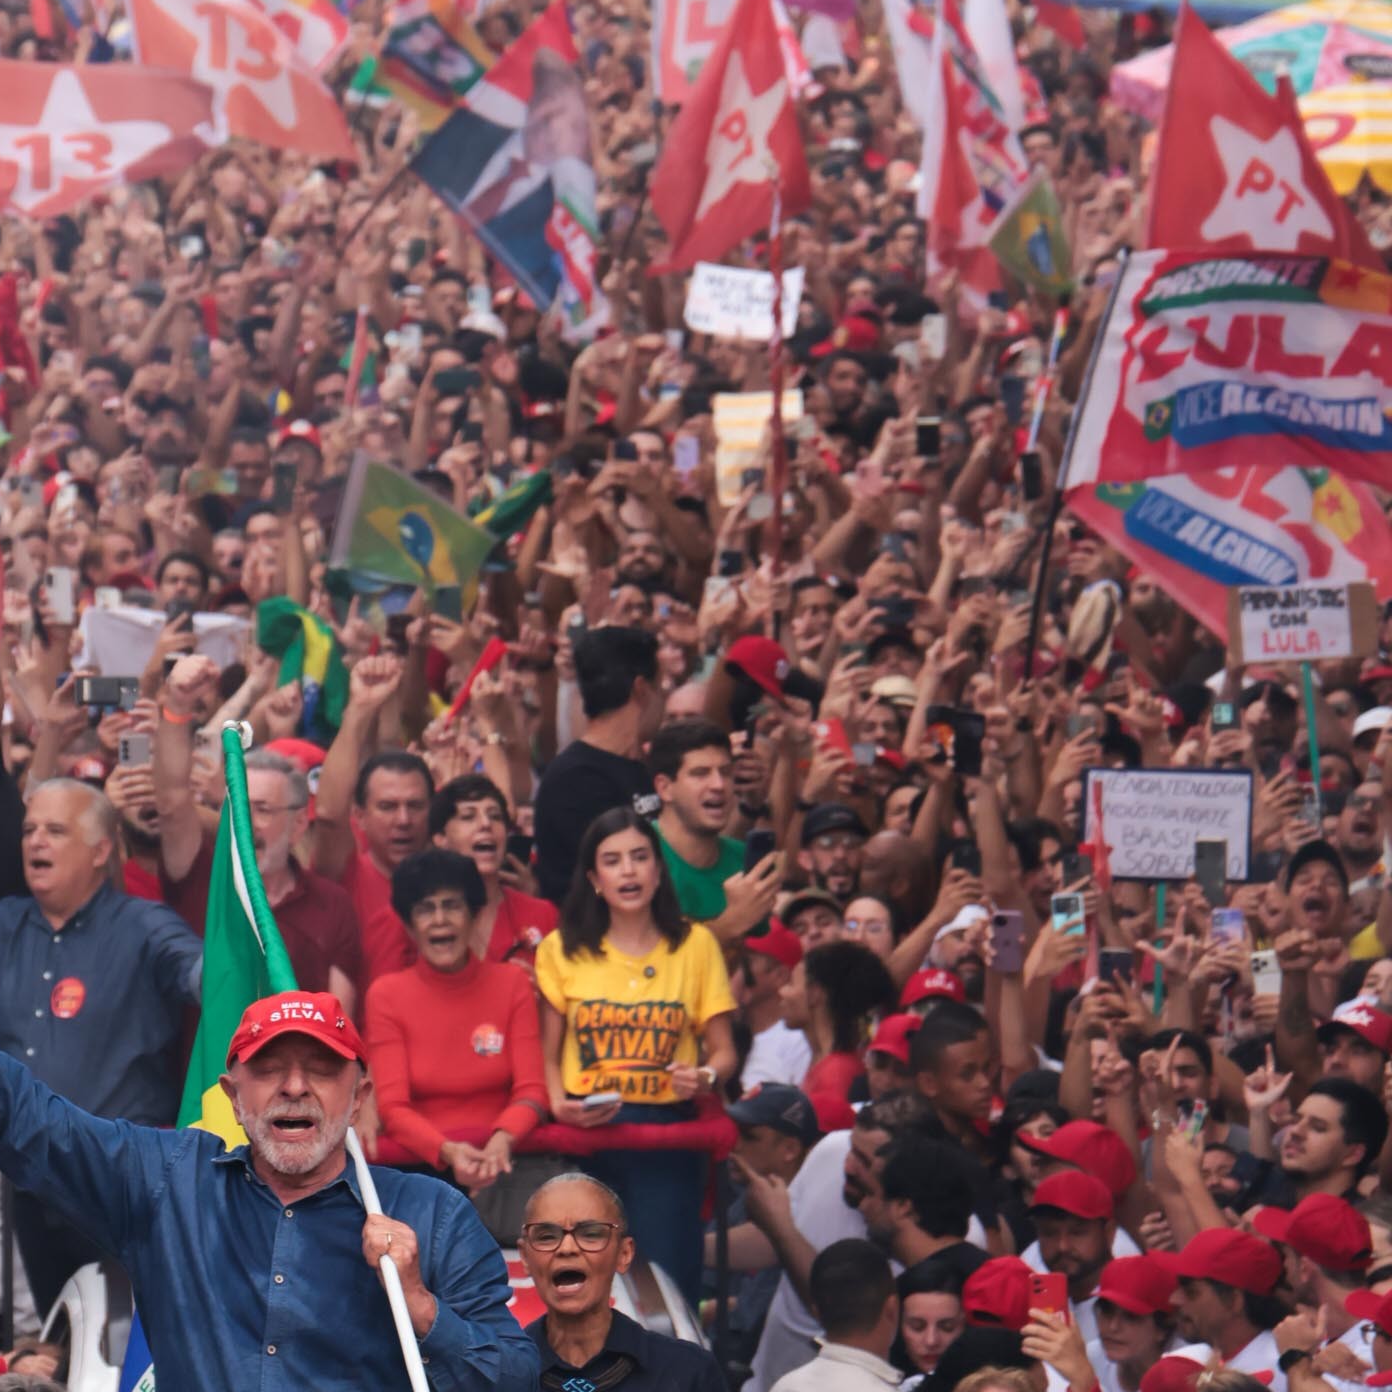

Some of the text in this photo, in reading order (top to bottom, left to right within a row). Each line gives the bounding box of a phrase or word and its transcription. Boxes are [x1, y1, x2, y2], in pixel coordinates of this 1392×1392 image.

[192, 4, 282, 81] 13
[13, 131, 113, 192] 13
[718, 110, 755, 172] PT
[1236, 157, 1305, 224] PT
[1142, 257, 1319, 305] PRESIDENTE
[1262, 629, 1321, 654] LULA
[270, 1007, 326, 1022] SILVA
[641, 1075, 660, 1096] 13
